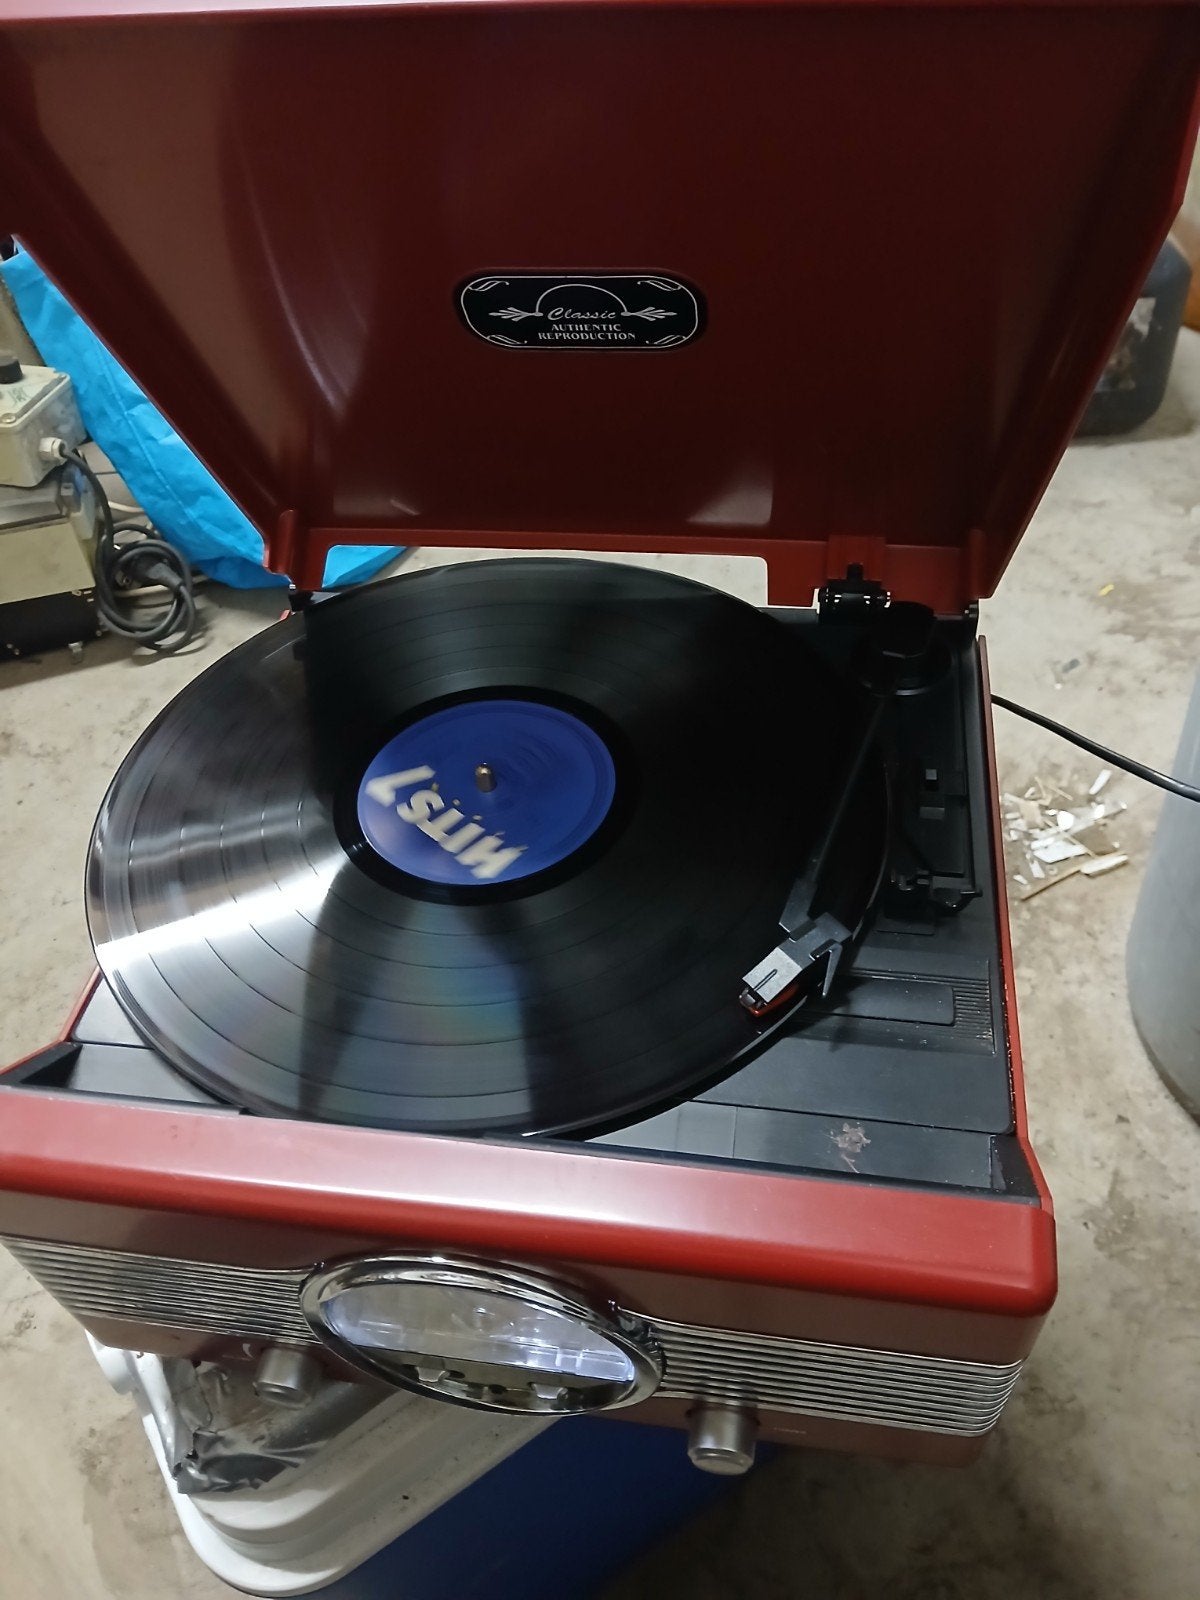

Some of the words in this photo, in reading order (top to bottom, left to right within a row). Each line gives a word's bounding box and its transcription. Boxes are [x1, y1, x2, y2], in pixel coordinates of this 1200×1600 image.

[547, 307, 616, 321] Classic
[551, 323, 622, 332] AUTHENTIC
[537, 331, 637, 341] REPRODUCTION
[365, 764, 436, 807] 7
[396, 787, 528, 879] HITS
